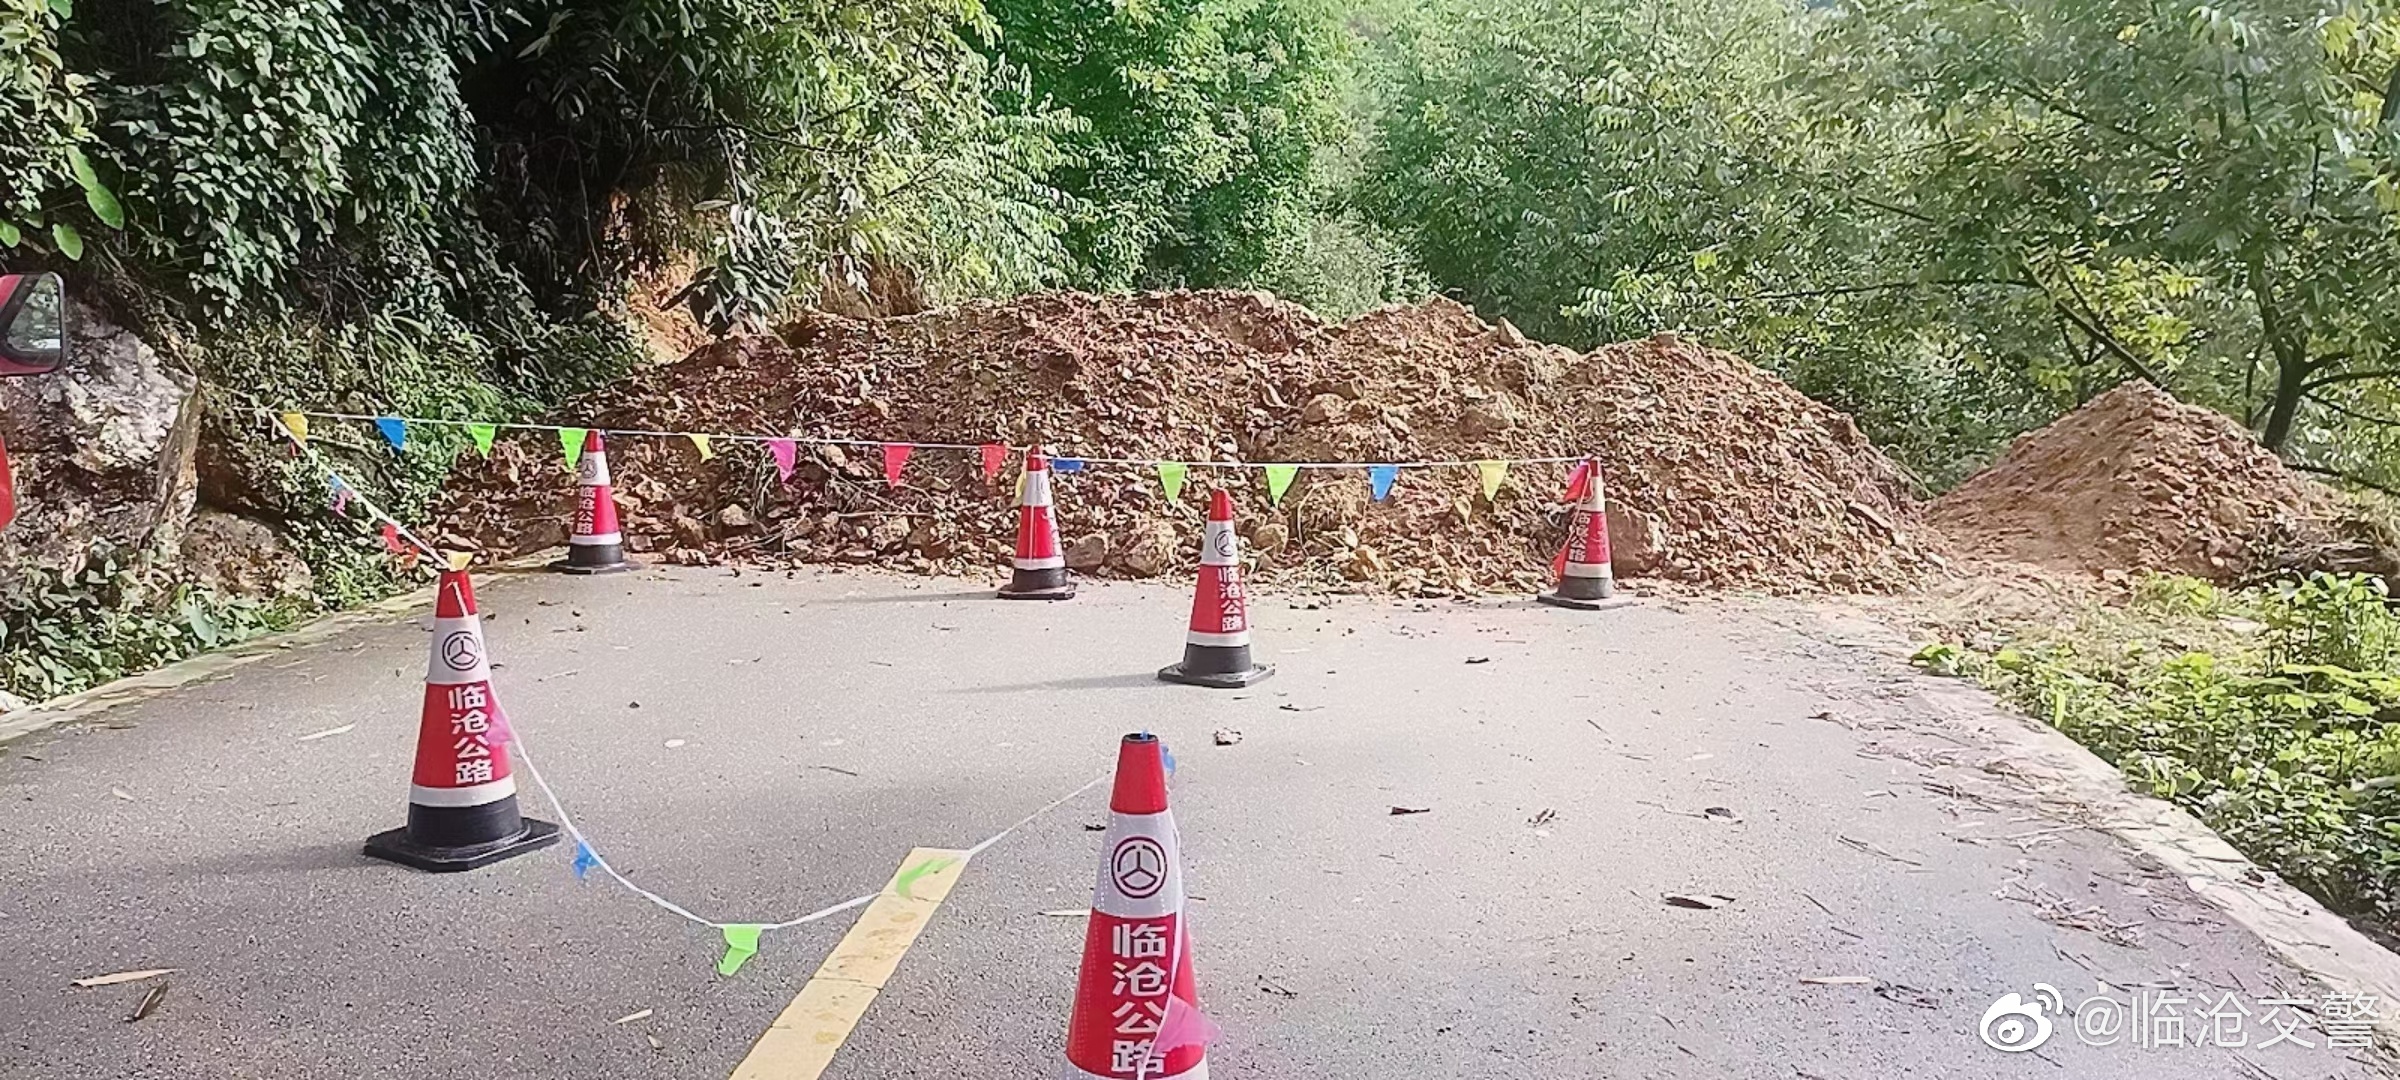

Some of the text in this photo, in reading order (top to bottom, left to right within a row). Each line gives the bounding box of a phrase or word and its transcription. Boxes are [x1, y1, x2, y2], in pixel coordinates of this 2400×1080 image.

[1218, 567, 1241, 632] 临沧公路
[448, 685, 494, 784] 临沧公路
[1111, 923, 1168, 1073] 临沧公路
